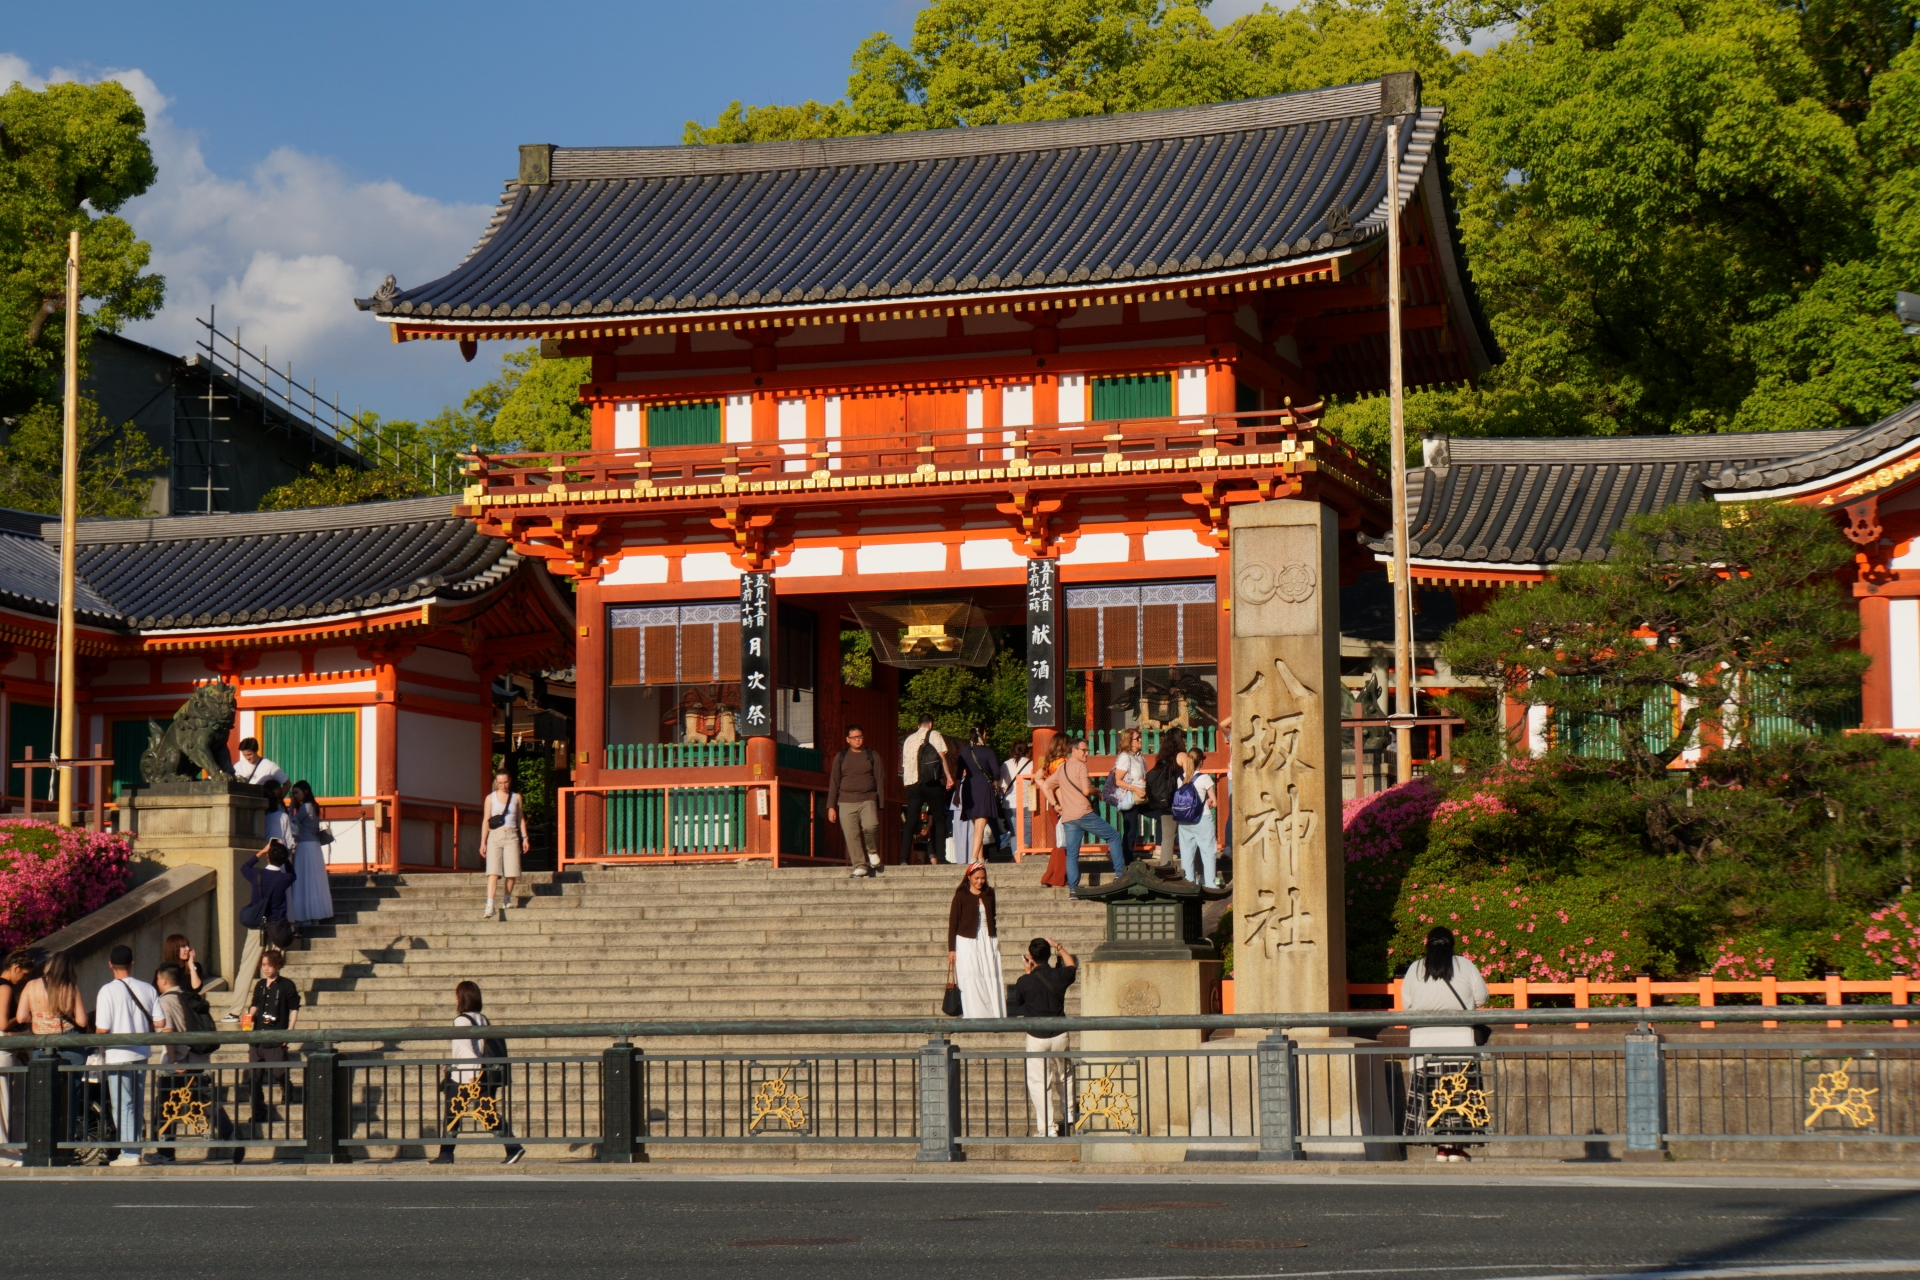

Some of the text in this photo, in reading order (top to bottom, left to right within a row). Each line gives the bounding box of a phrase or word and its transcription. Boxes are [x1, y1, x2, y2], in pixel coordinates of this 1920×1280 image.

[742, 574, 754, 629] 午前十時
[753, 574, 769, 627] 五月十五日
[1028, 561, 1041, 613] 午前十一時
[1039, 561, 1054, 612] 五月十五日
[746, 637, 767, 726] 月次祭
[1031, 624, 1051, 715] 献酒祭
[1236, 657, 1318, 960] 八坂神社
